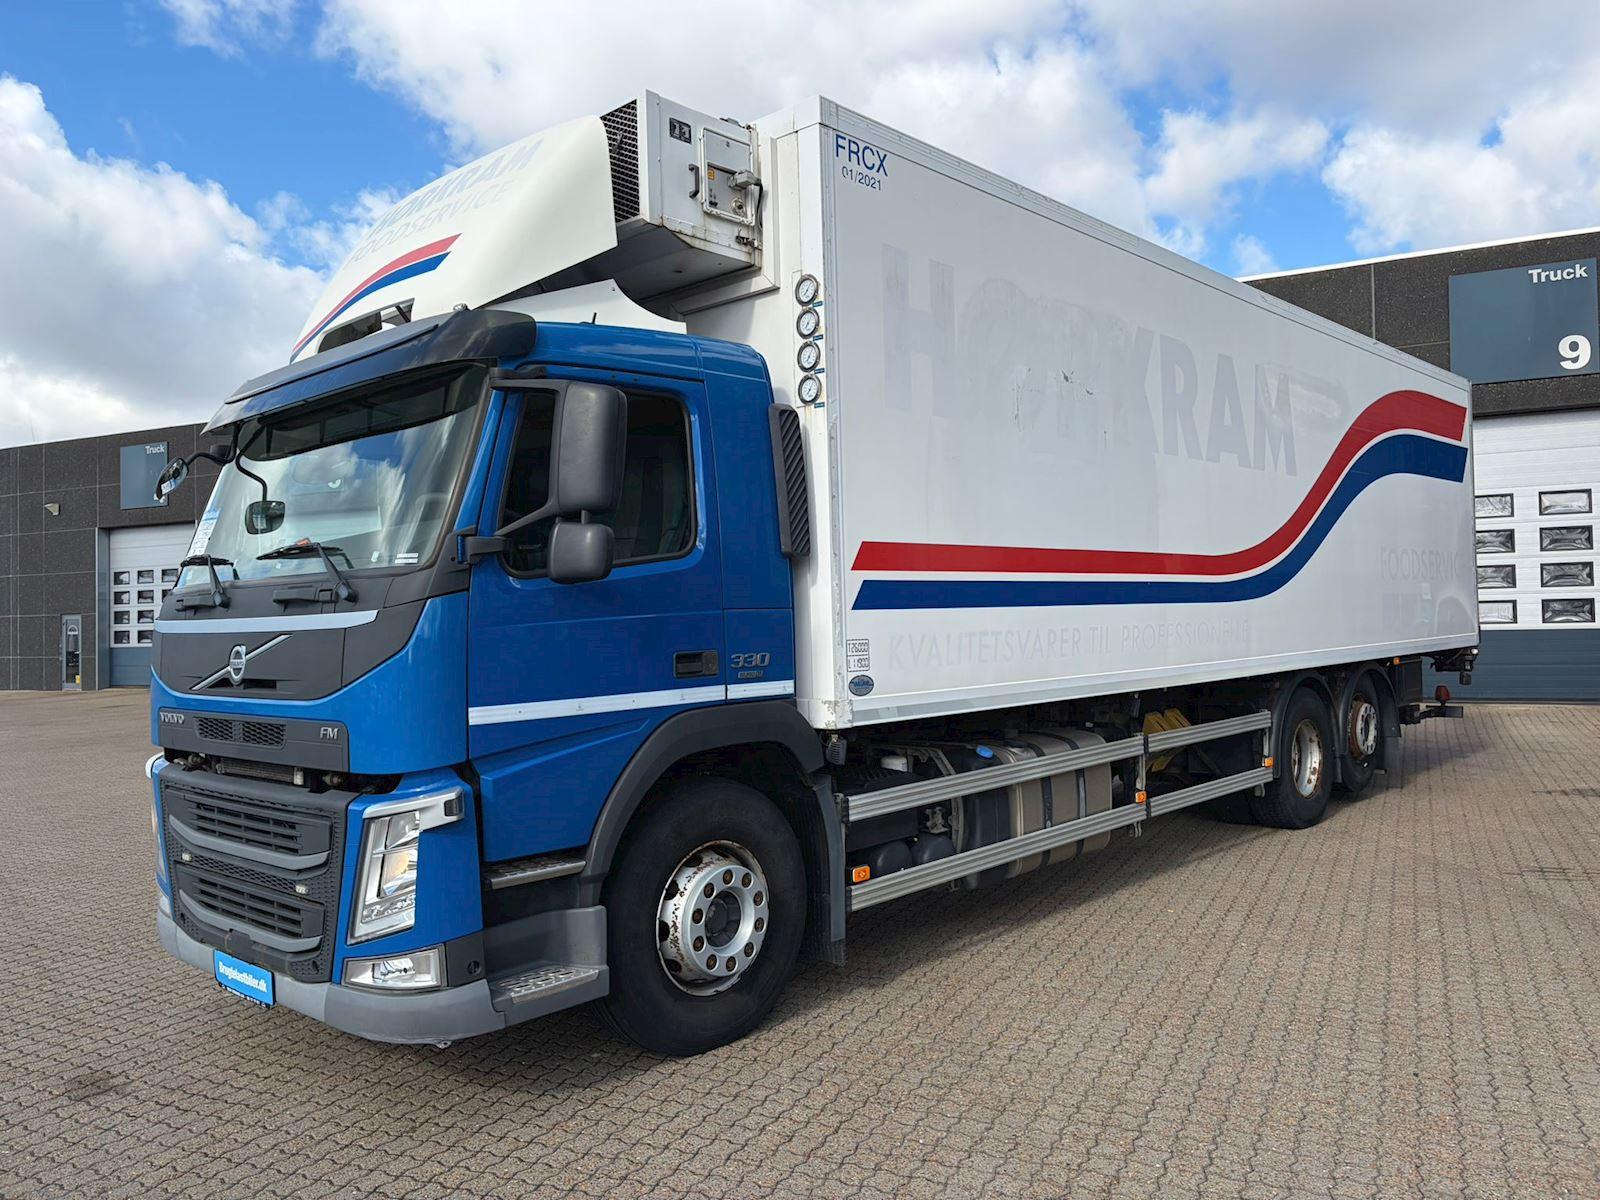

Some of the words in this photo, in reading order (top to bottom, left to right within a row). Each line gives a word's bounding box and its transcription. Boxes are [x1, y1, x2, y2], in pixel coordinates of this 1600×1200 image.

[835, 134, 889, 177] FRCX
[841, 166, 882, 191] 01/2021
[1527, 263, 1589, 284] Truck
[1557, 334, 1592, 370] 9
[144, 444, 165, 454] Truck
[889, 626, 1081, 671] KVALITETSVARER
[1088, 625, 1112, 657] TIL
[730, 652, 770, 668] 330
[159, 711, 185, 724] VOLVO
[320, 726, 339, 740] FM
